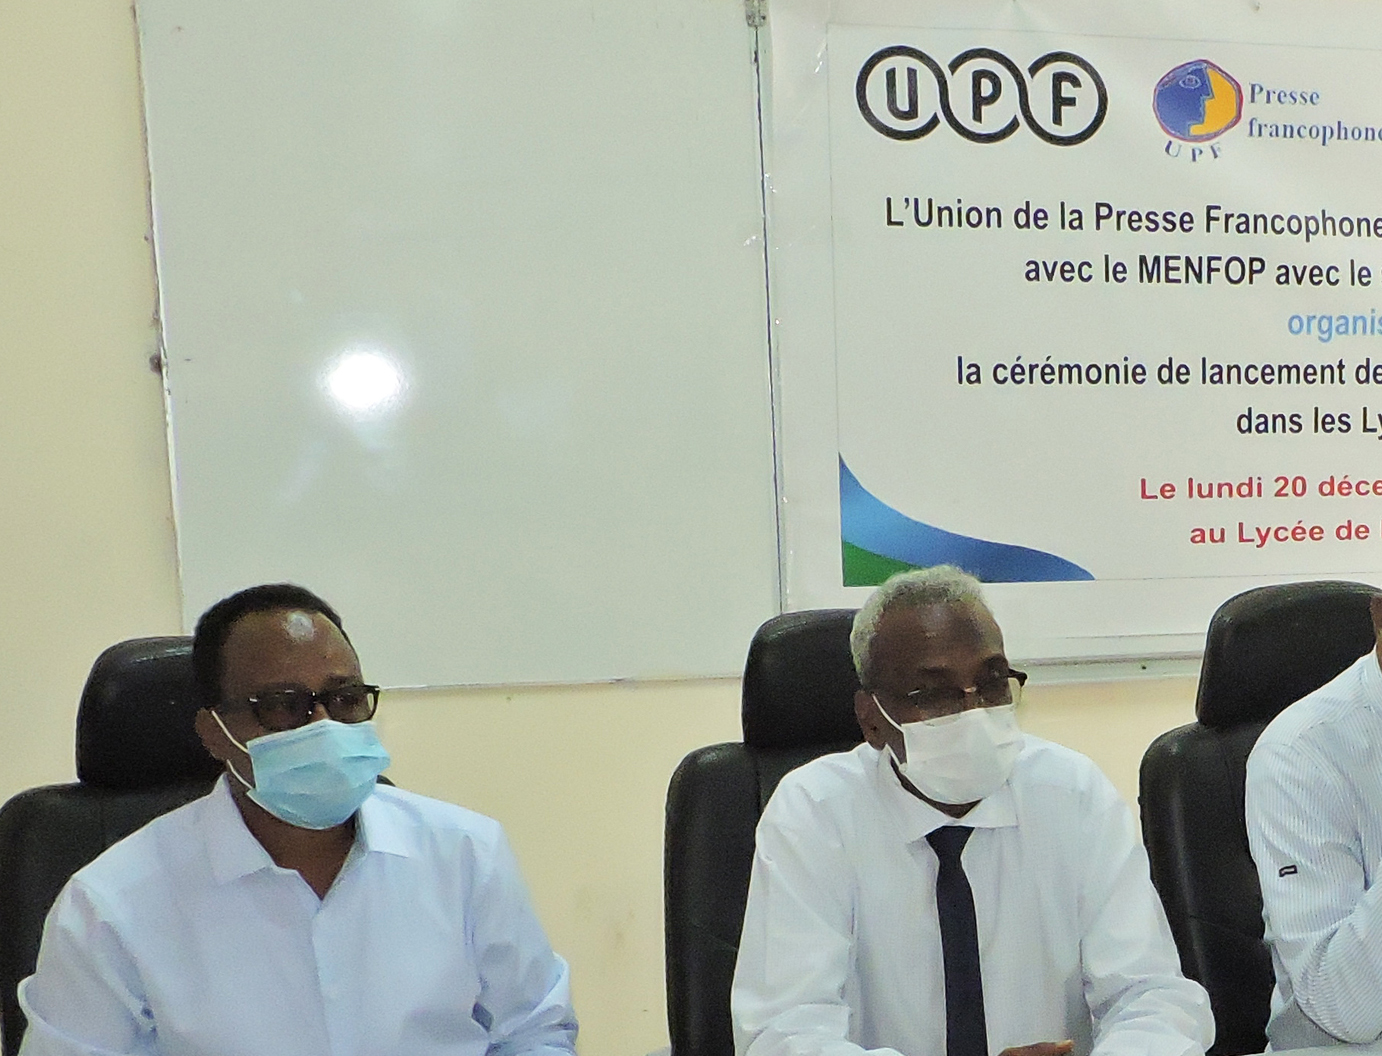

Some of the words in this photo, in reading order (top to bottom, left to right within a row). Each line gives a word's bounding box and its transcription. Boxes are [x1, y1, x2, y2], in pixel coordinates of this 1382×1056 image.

[886, 66, 1082, 127] UPF
[1249, 82, 1320, 106] Presse
[1165, 140, 1222, 162] UPF
[886, 197, 1001, 228] L’Union
[1014, 201, 1048, 229] de
[1061, 201, 1083, 230] la
[1096, 202, 1194, 233] Presse
[1025, 259, 1092, 283] avec
[1104, 255, 1127, 283] le
[1139, 255, 1265, 285] MENFOP
[1276, 265, 1339, 286] avec
[1351, 259, 1371, 286] le
[958, 356, 981, 384] la
[993, 356, 1146, 384] cérémonie
[1158, 357, 1190, 384] de
[1202, 357, 1345, 384] lancement
[1237, 407, 1302, 434] dans
[1314, 407, 1351, 434] les
[1141, 478, 1176, 499] Le
[1187, 477, 1262, 499] lundi
[1275, 476, 1307, 498] 20
[1190, 528, 1225, 544] au
[1239, 520, 1324, 548] Lycée
[1336, 520, 1369, 540] de
